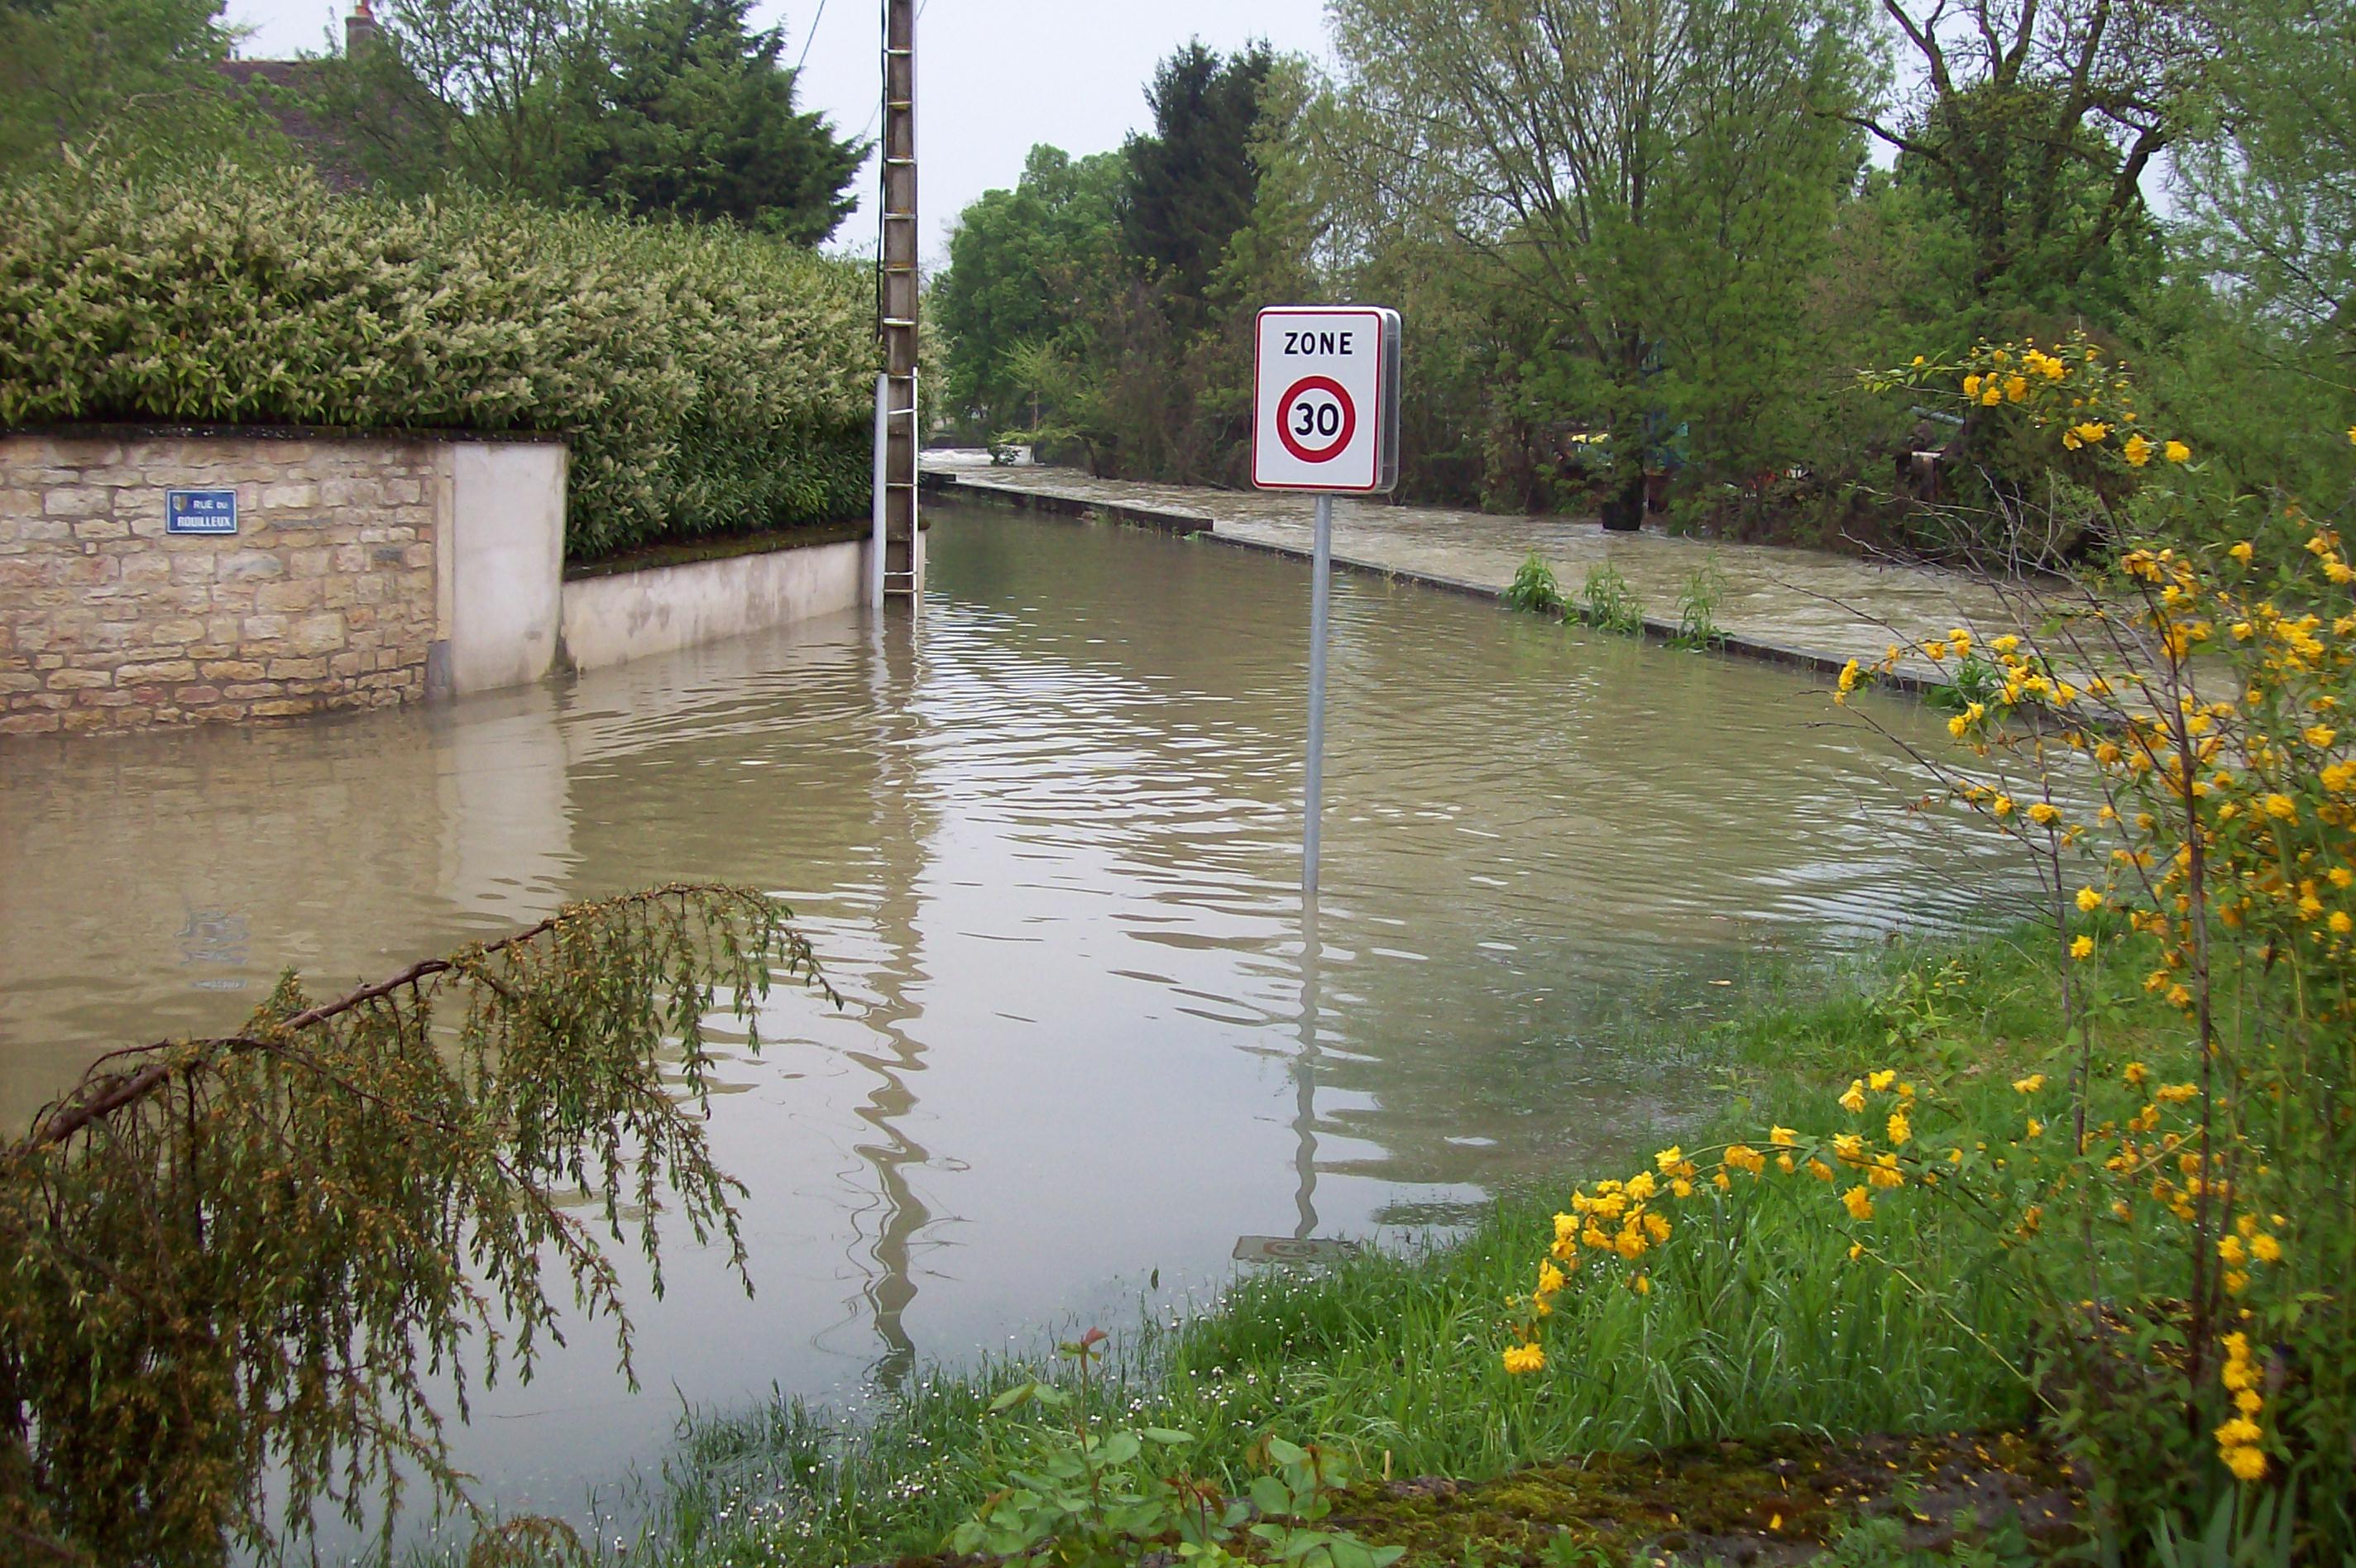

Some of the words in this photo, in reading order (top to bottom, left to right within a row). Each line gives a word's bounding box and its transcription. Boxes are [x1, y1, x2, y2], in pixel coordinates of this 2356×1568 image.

[1284, 332, 1353, 355] ZONE
[1295, 403, 1339, 437] 30
[193, 500, 213, 509] RUE
